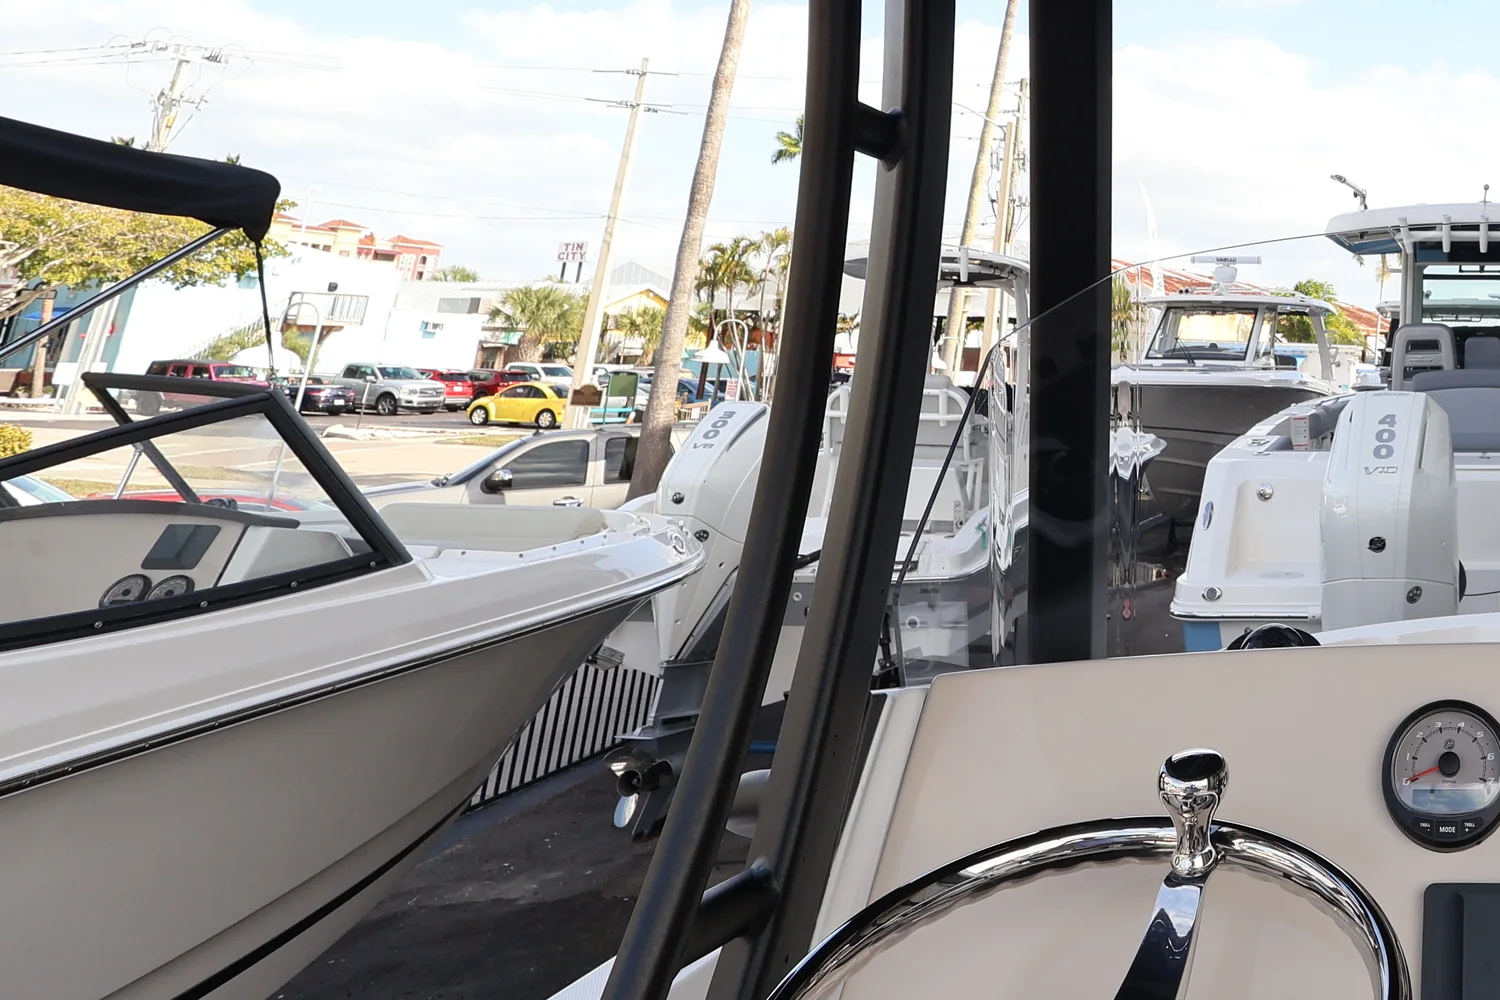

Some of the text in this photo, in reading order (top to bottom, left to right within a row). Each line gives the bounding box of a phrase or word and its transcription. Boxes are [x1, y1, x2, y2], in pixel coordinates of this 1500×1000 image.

[563, 242, 585, 251] TIN
[557, 251, 587, 260] CITY
[702, 410, 736, 440] 300
[1373, 413, 1397, 460] 400
[1487, 753, 1495, 761] 6
